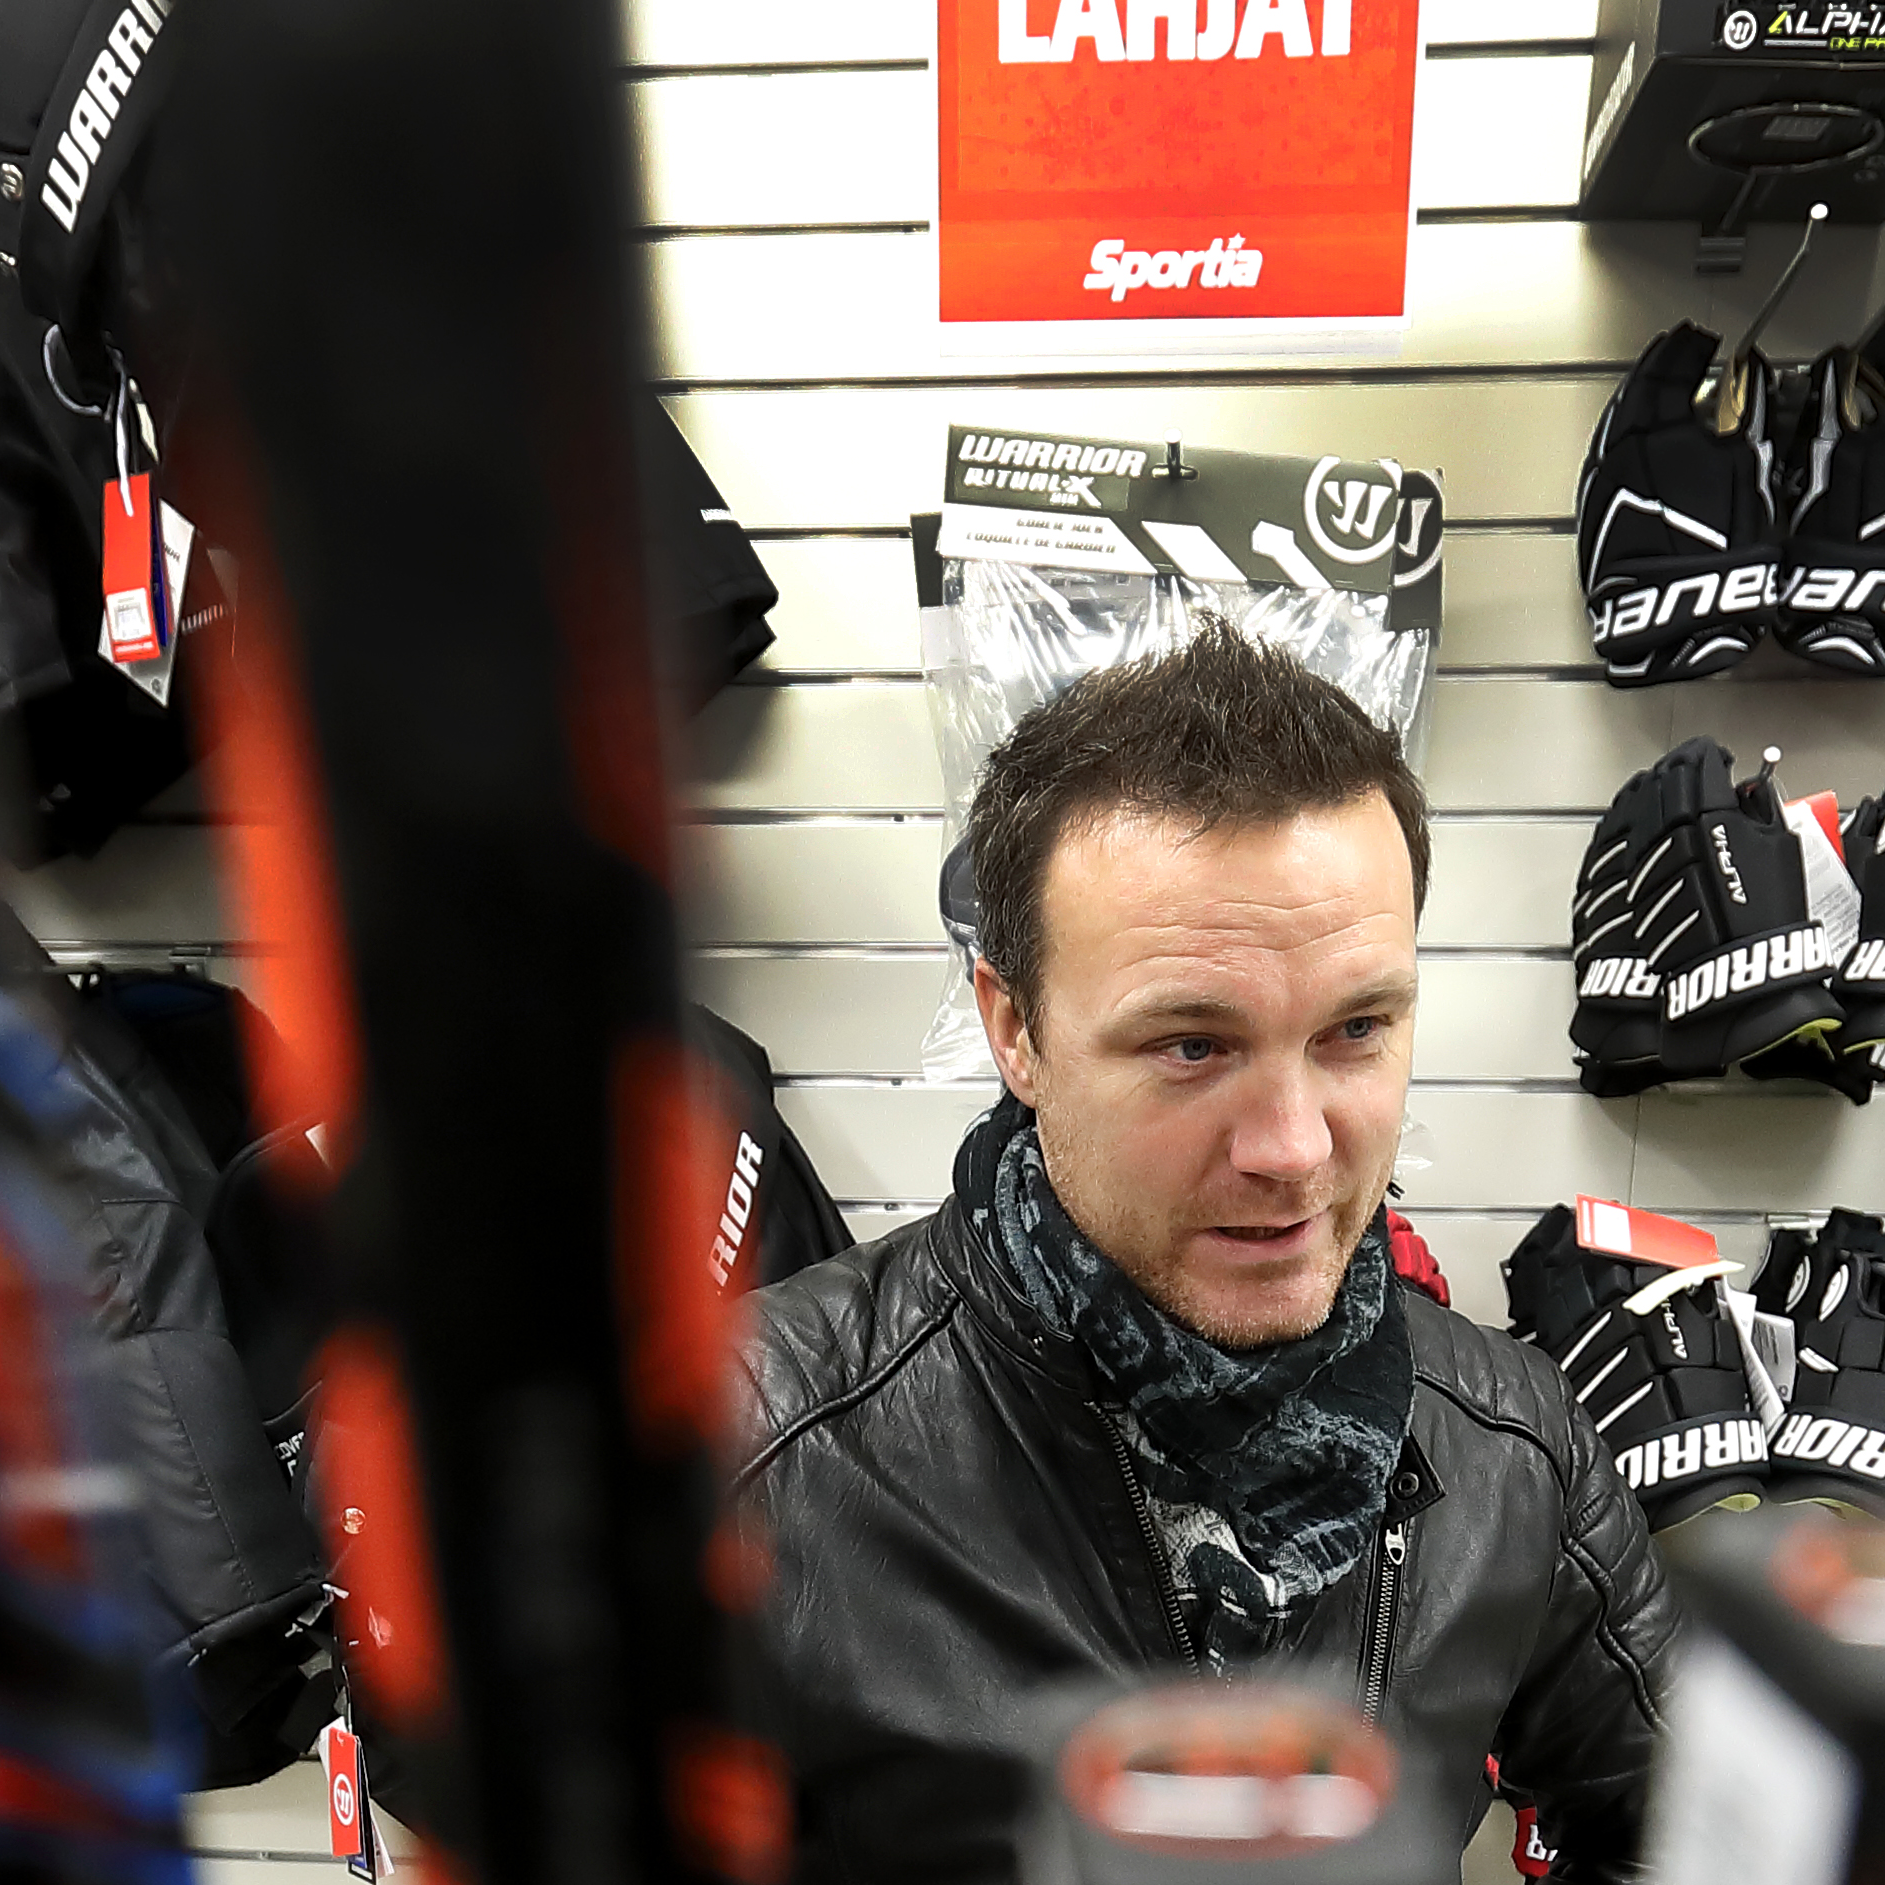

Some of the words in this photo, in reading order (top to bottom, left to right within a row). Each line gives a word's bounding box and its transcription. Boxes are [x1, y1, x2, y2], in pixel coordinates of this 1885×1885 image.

[998, 0, 1352, 64] LAHJAT
[41, 0, 174, 234] WARRI
[1083, 233, 1263, 302] Sportia
[958, 434, 1148, 478] WARRIOR
[1711, 824, 1747, 904] ALPHA
[1579, 956, 1664, 998] RIOR
[1667, 927, 1831, 1021] ARRIOR
[708, 1131, 764, 1287] RIOR
[1616, 1419, 1769, 1490] ARRIO
